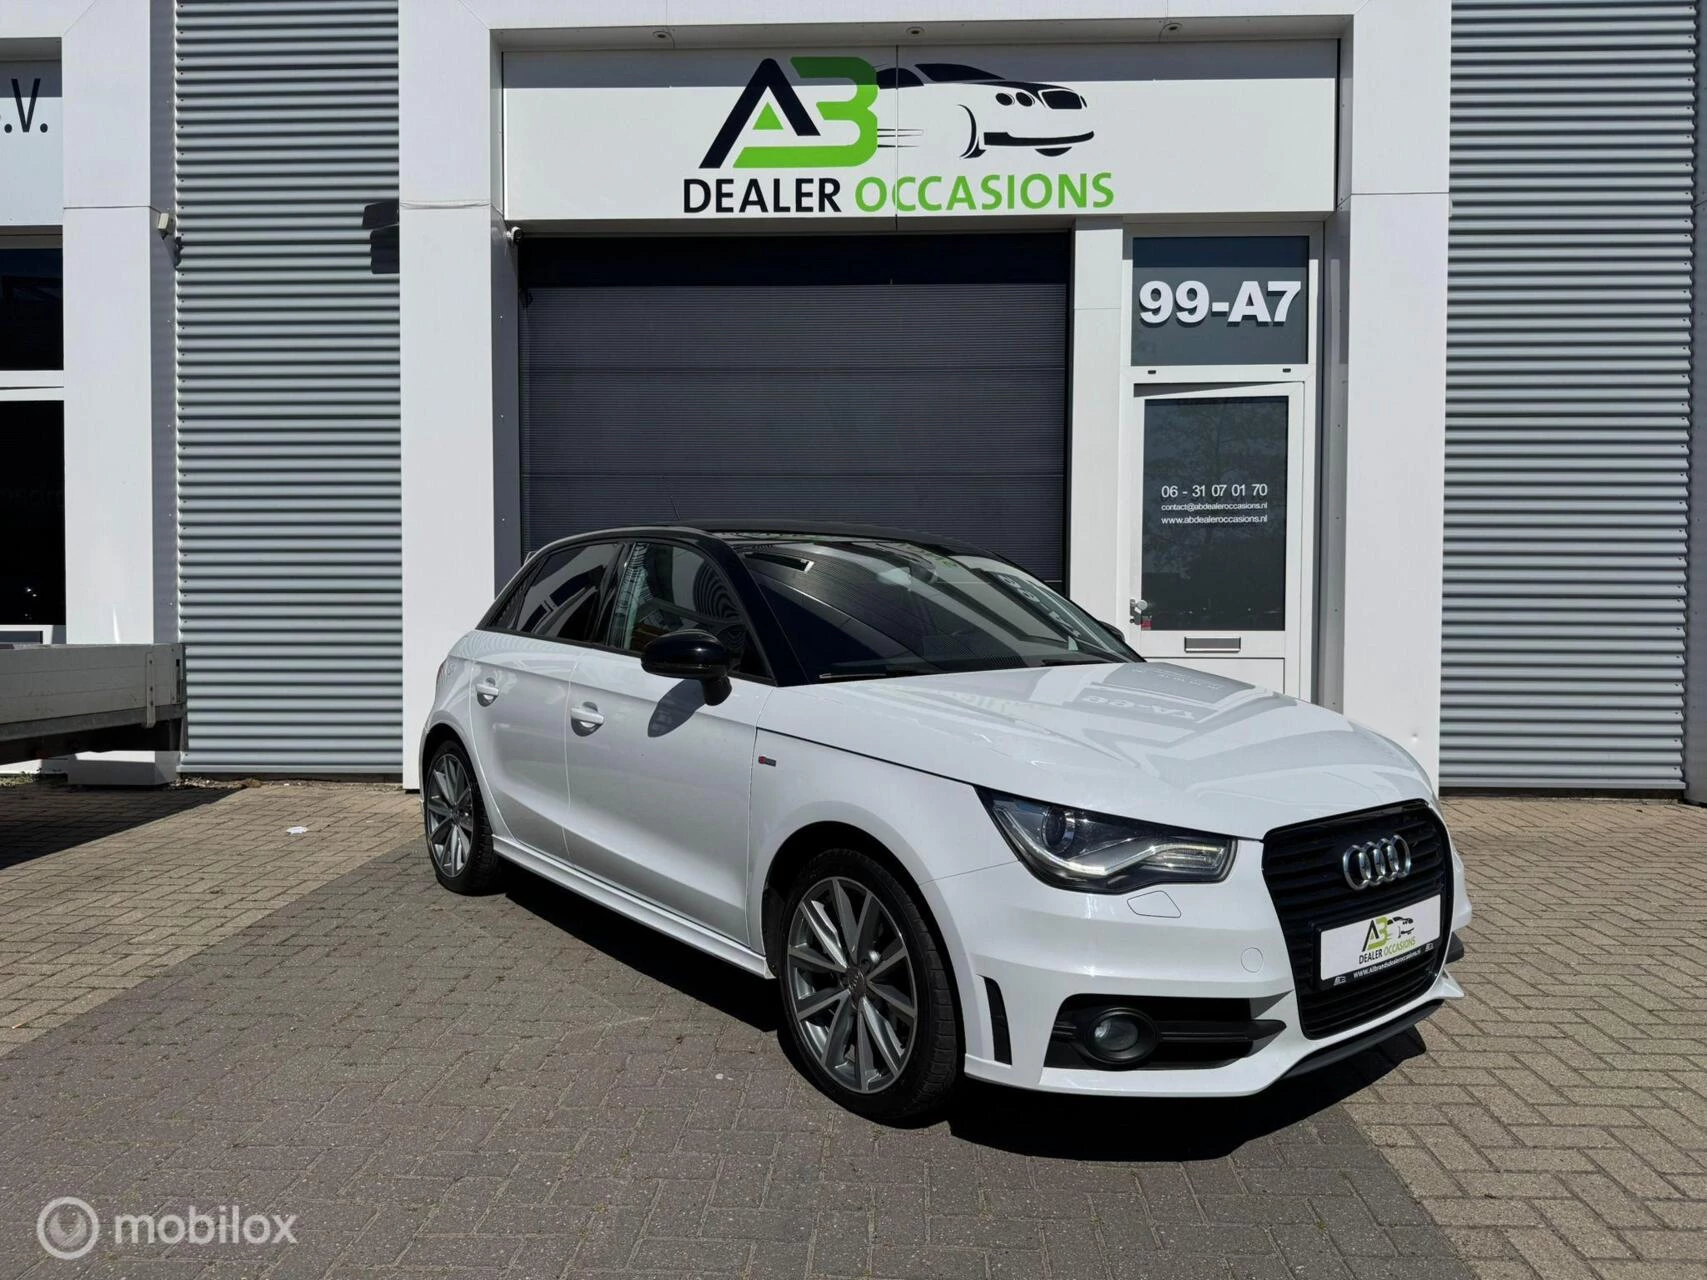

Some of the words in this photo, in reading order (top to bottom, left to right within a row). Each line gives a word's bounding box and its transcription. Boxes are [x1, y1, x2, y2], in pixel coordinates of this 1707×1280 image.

[0, 78, 49, 134] .V.
[683, 177, 842, 214] DEALER
[854, 172, 1115, 213] OCCASIONS
[1139, 280, 1302, 325] 99-A7
[1161, 485, 1179, 498] 06
[1192, 484, 1206, 497] 31
[1211, 484, 1227, 497] 07
[1231, 484, 1246, 496] 01
[1251, 483, 1268, 496] 70
[1161, 502, 1268, 512] contact@abdealeroccasions.nl
[1161, 515, 1268, 524] www.abdealeroccasions.nl
[1359, 949, 1383, 965] DEALER
[1383, 936, 1416, 956] OCCASIONS
